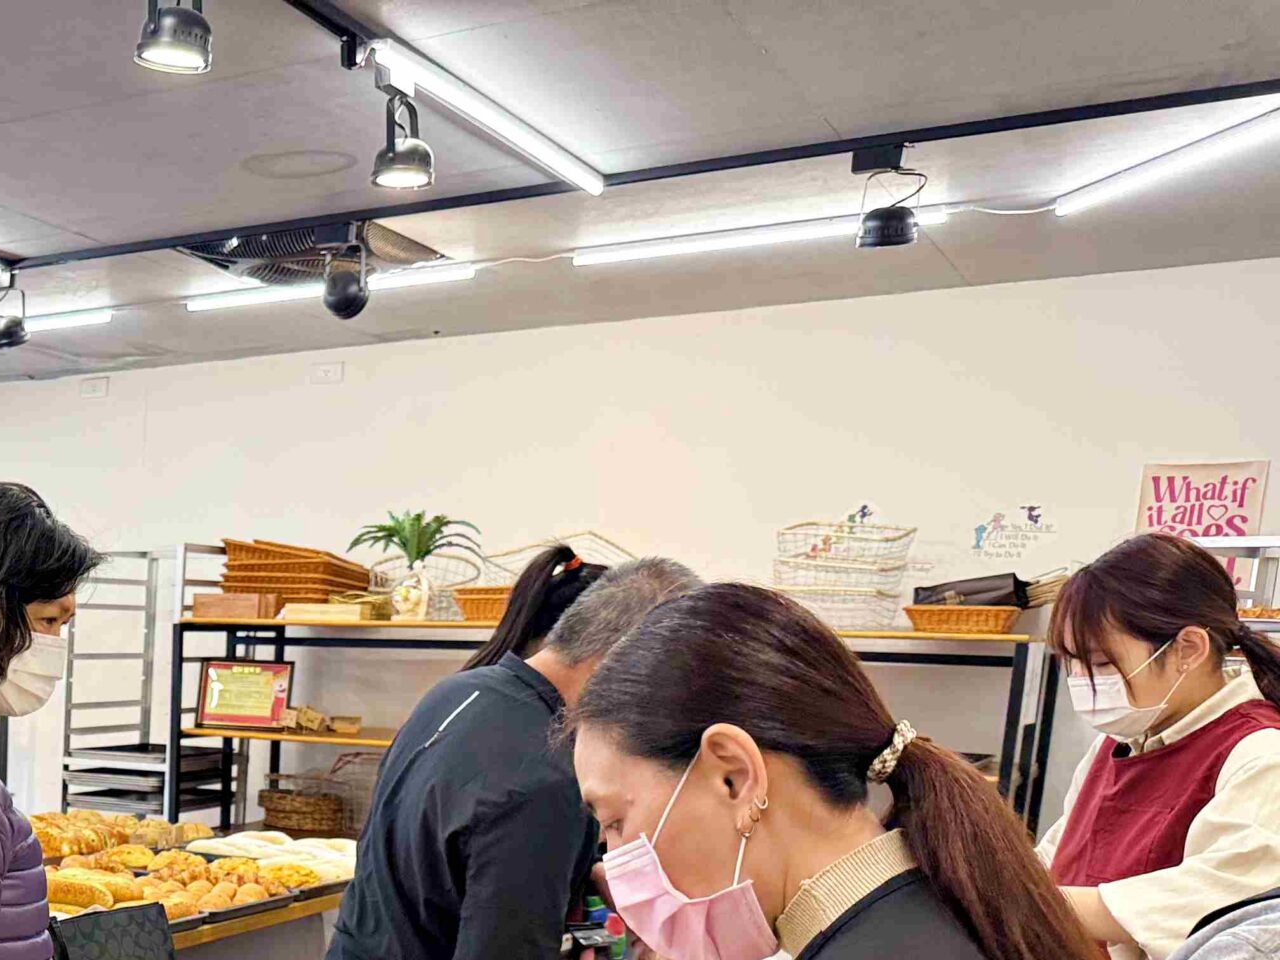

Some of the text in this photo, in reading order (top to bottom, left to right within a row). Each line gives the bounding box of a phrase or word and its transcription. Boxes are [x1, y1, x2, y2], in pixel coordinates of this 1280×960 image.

[1152, 475, 1257, 508] What if
[1147, 502, 1204, 527] it all
